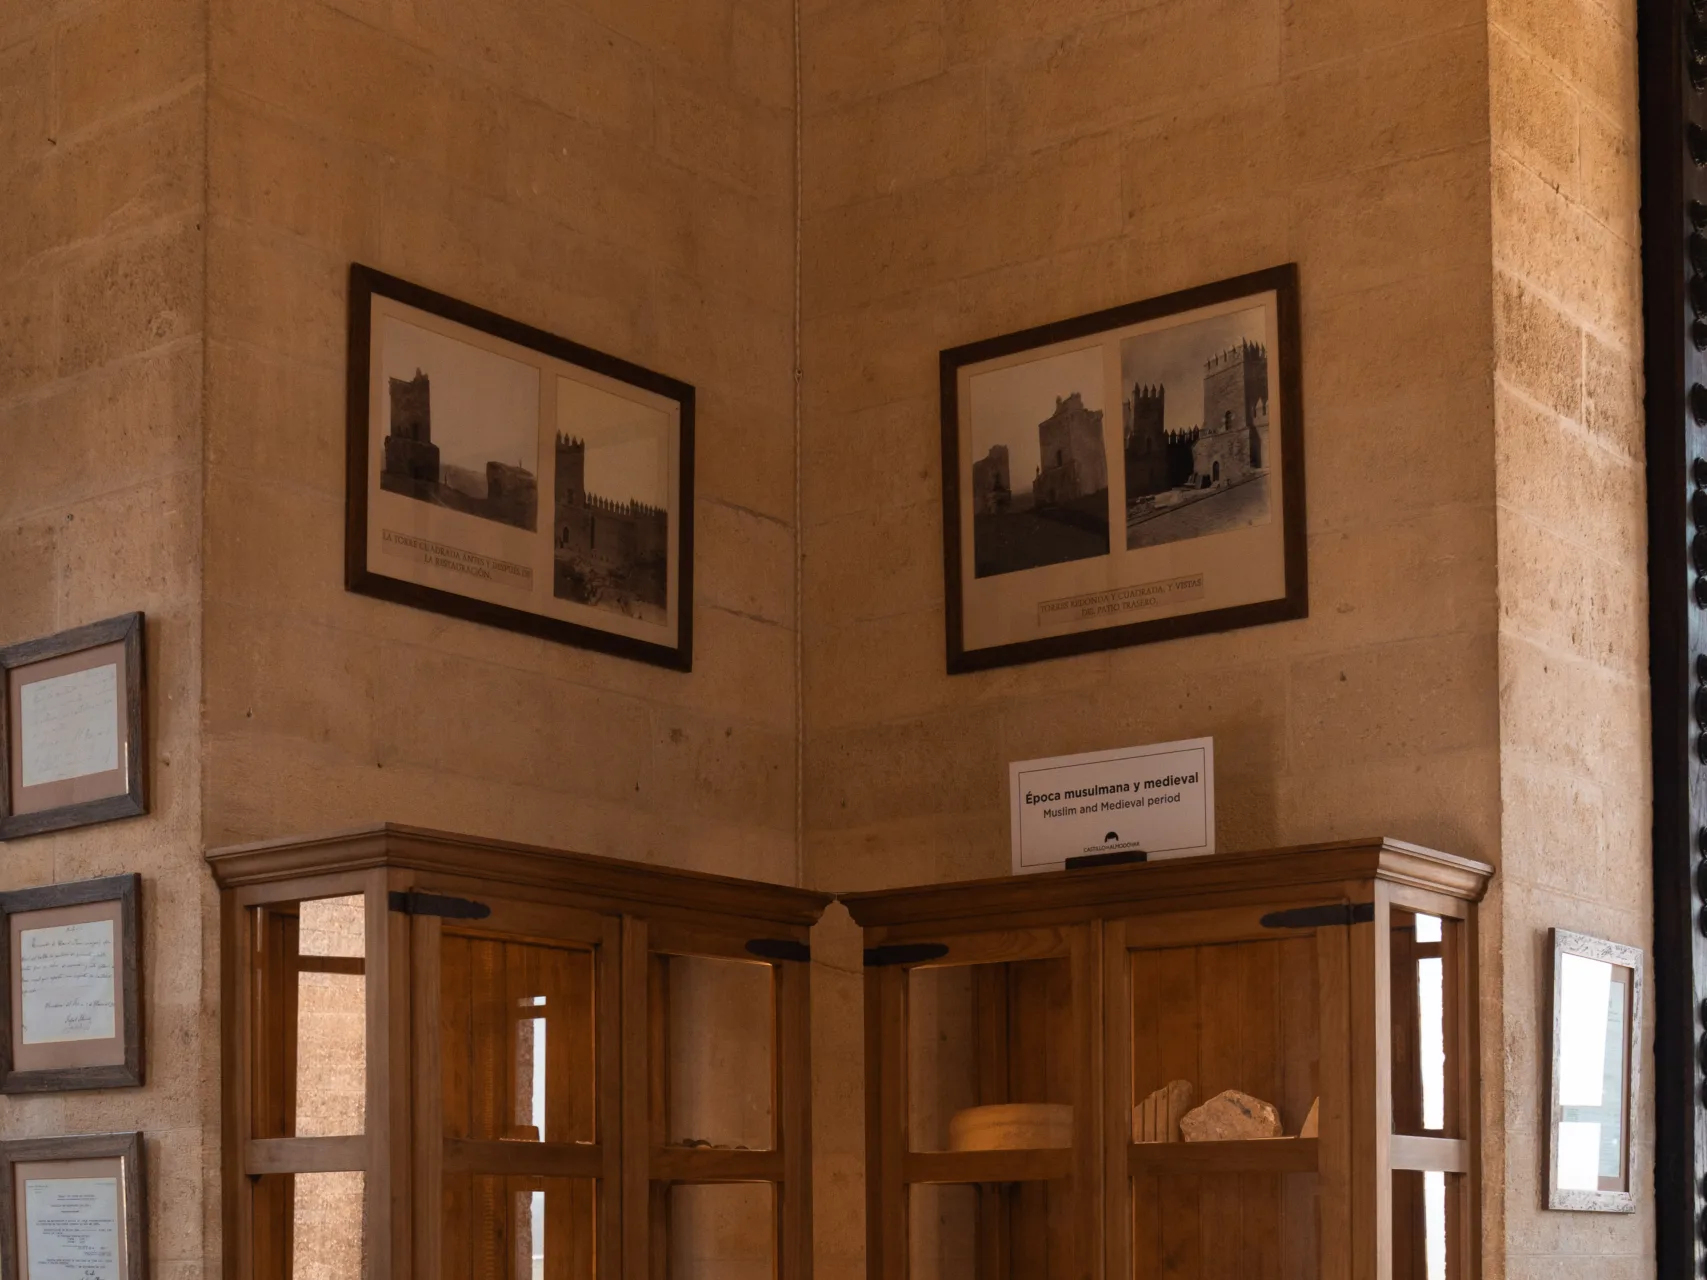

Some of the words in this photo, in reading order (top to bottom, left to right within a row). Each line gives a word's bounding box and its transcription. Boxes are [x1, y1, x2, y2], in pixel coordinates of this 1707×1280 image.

[382, 531, 392, 541] LA
[394, 535, 418, 548] TORRE
[419, 541, 461, 560] CUADRADA
[486, 558, 491, 567] Y
[424, 553, 433, 563] LA
[1070, 594, 1109, 609] REDONDA
[1111, 593, 1117, 602] Y
[1168, 583, 1174, 592] Y
[1175, 578, 1202, 590] VISTAS
[1097, 603, 1120, 615] PATIO
[1025, 790, 1061, 806] Época
[1064, 783, 1130, 800] musulmana
[1133, 780, 1141, 792] y
[1144, 772, 1199, 789] medieval
[1043, 803, 1077, 819] Muslim
[1080, 802, 1098, 815] and
[1101, 796, 1145, 812] Medieval
[1147, 792, 1181, 807] period
